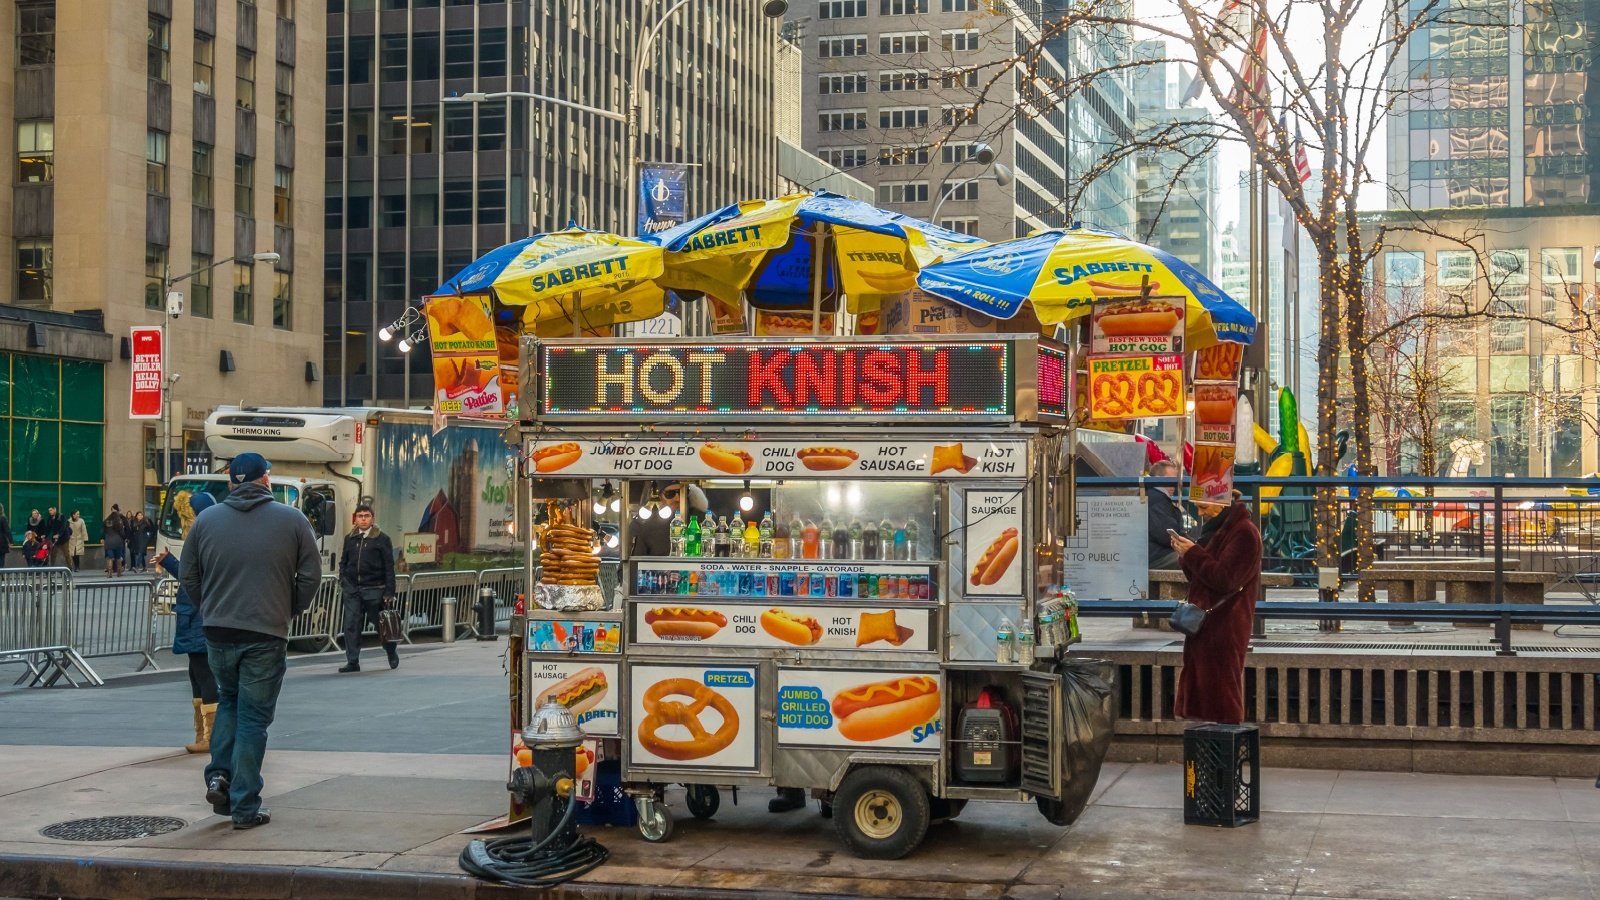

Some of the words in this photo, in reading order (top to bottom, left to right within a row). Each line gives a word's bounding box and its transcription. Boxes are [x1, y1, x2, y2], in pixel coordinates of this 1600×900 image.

[644, 217, 676, 232] Happy
[683, 225, 761, 253] SABRETT
[531, 255, 628, 293] SABRETT
[1054, 261, 1152, 285] SABRETT
[972, 291, 995, 305] ROLL
[641, 318, 674, 335] 1221
[135, 354, 160, 363] BETTE
[133, 362, 161, 371] MIDLER
[1093, 359, 1149, 373] PRETZEL
[594, 352, 726, 405] HOT
[748, 350, 950, 408] KNISH
[464, 393, 498, 409] Patties
[1204, 432, 1216, 440] HOT
[590, 446, 635, 456] JUMBO
[639, 447, 695, 456] GRILLED
[762, 447, 796, 457] CHILI
[878, 446, 907, 456] HOT
[984, 448, 1014, 458] HOT
[614, 460, 641, 470] HOT
[645, 460, 673, 470] DOG
[765, 461, 795, 472] DOG
[859, 460, 925, 471] SAUSAGE
[982, 462, 1015, 473] KISH
[984, 496, 1004, 504] HOT
[971, 506, 1017, 515] SAUSAGE
[1072, 553, 1085, 561] TO
[1089, 553, 1120, 561] PUBLIC
[733, 615, 756, 624] CHILI
[832, 618, 852, 626] HOT
[735, 626, 756, 634] DOG
[828, 627, 857, 637] KNISH
[707, 675, 750, 684] PRETZEL
[781, 690, 818, 700] JUMBO
[781, 701, 826, 712] GRILLED
[577, 709, 617, 725] ABRETT
[781, 714, 802, 725] HOT
[805, 715, 829, 725] DOG
